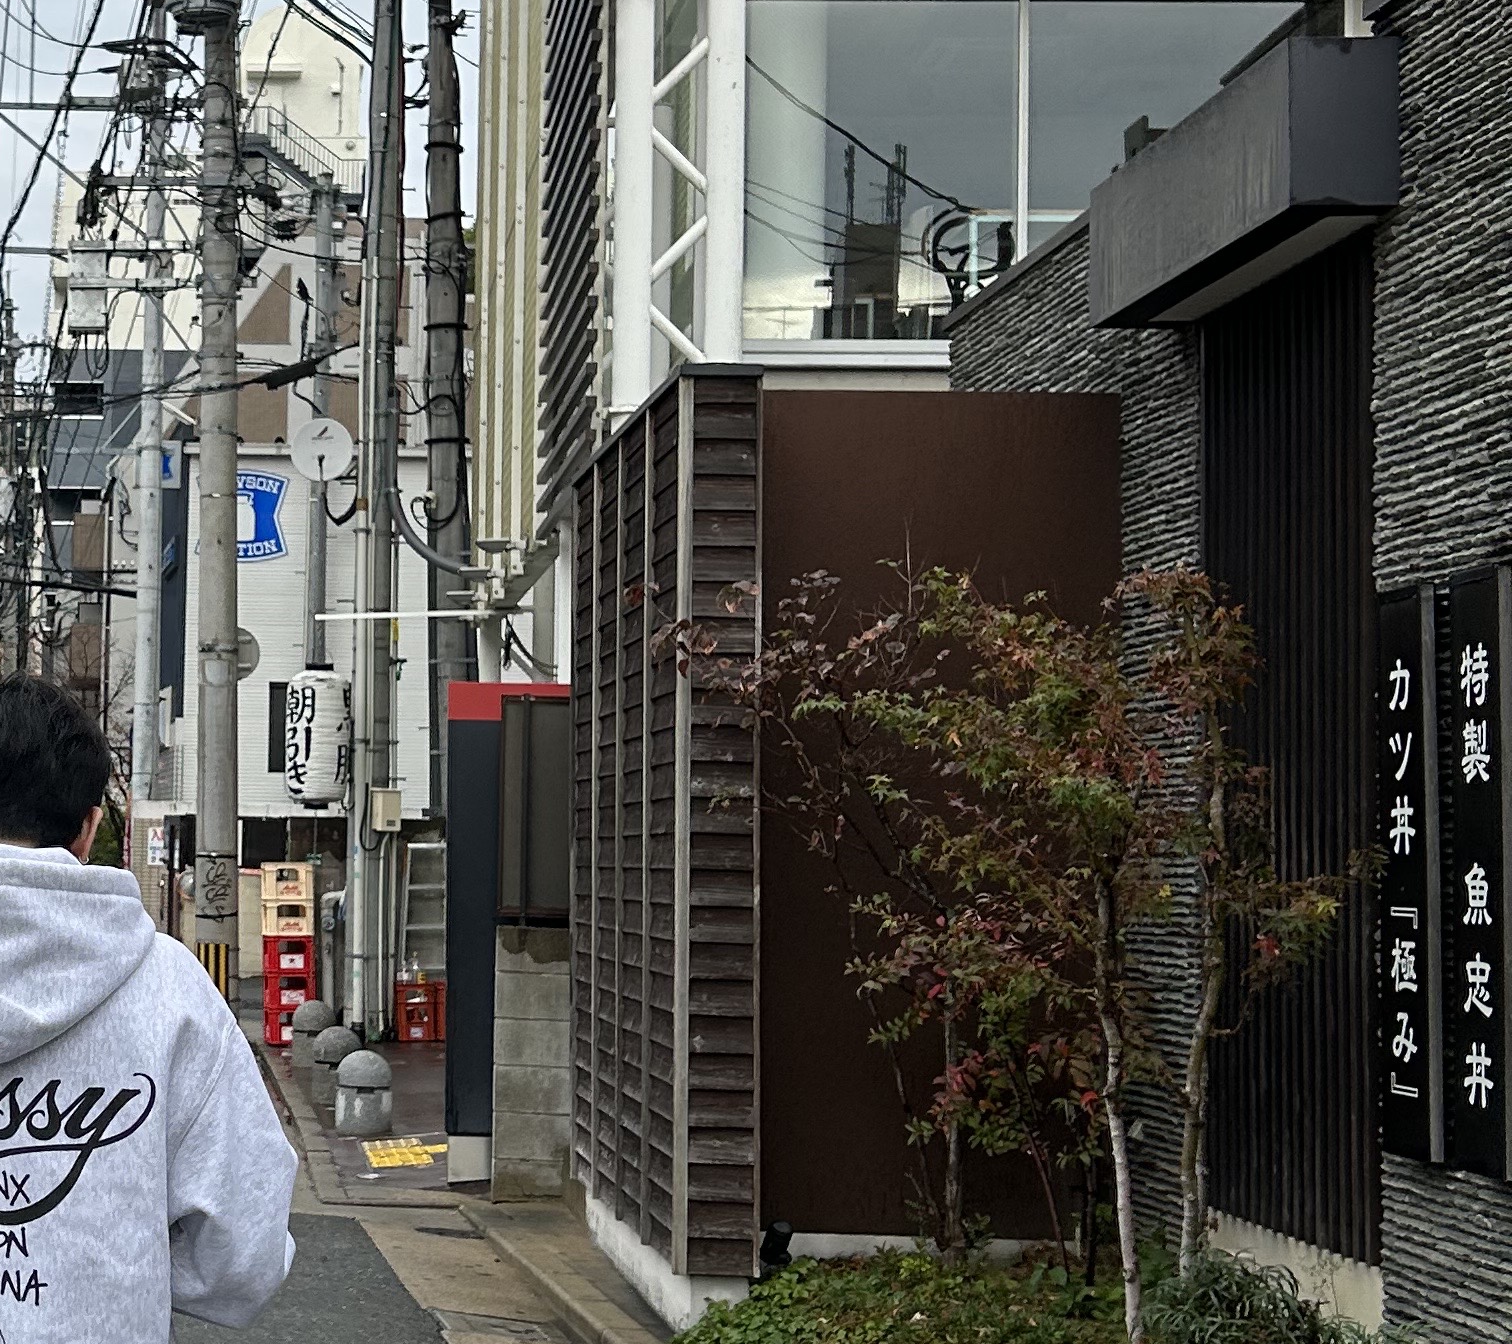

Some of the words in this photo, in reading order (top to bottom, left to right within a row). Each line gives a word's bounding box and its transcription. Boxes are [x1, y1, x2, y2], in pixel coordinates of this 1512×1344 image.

[1389, 658, 1417, 856] カツ丼
[1460, 641, 1491, 785] 特製
[1462, 862, 1495, 1110] 魚忠丼
